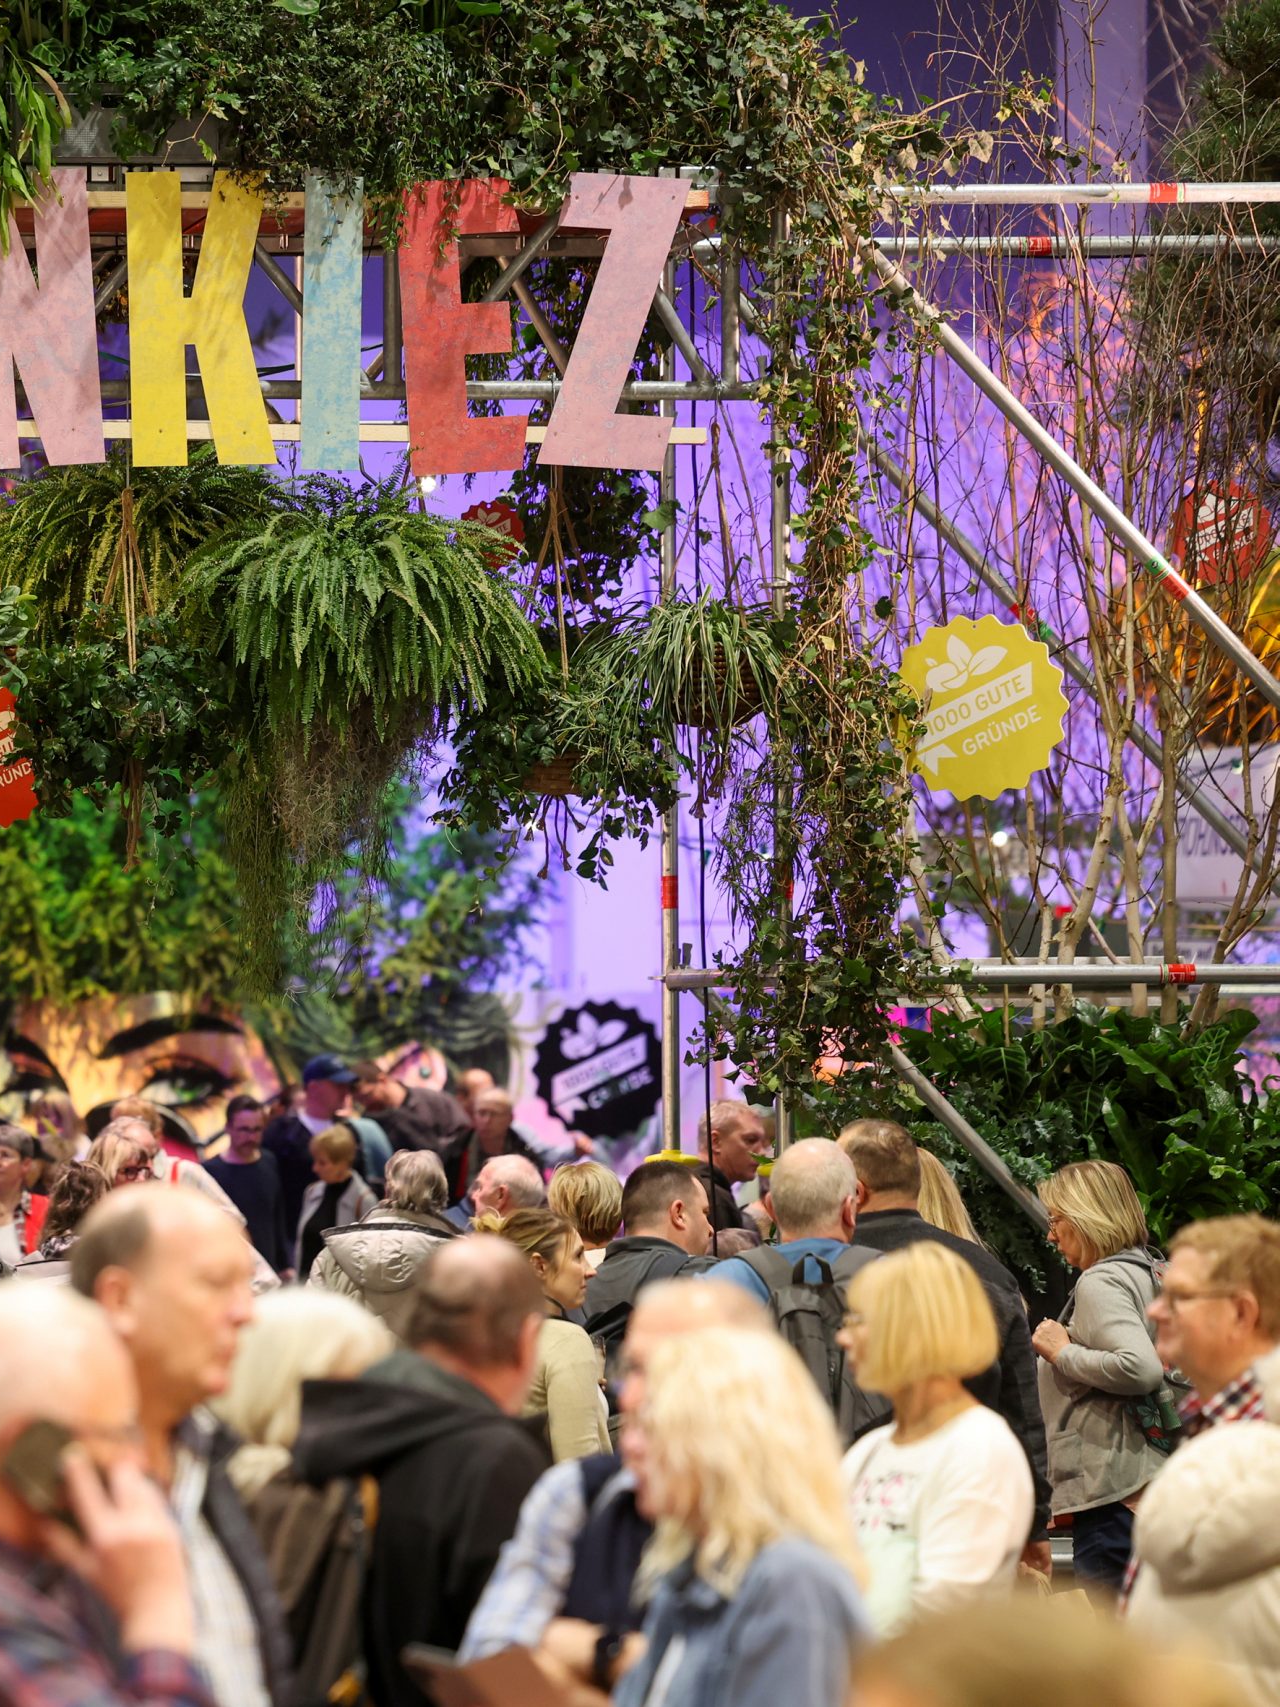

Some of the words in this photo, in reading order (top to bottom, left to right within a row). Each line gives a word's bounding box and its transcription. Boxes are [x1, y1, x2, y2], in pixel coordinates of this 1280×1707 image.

[925, 701, 971, 737] 1000
[974, 674, 1025, 711] GUTE
[961, 704, 1042, 756] GRÜNDE
